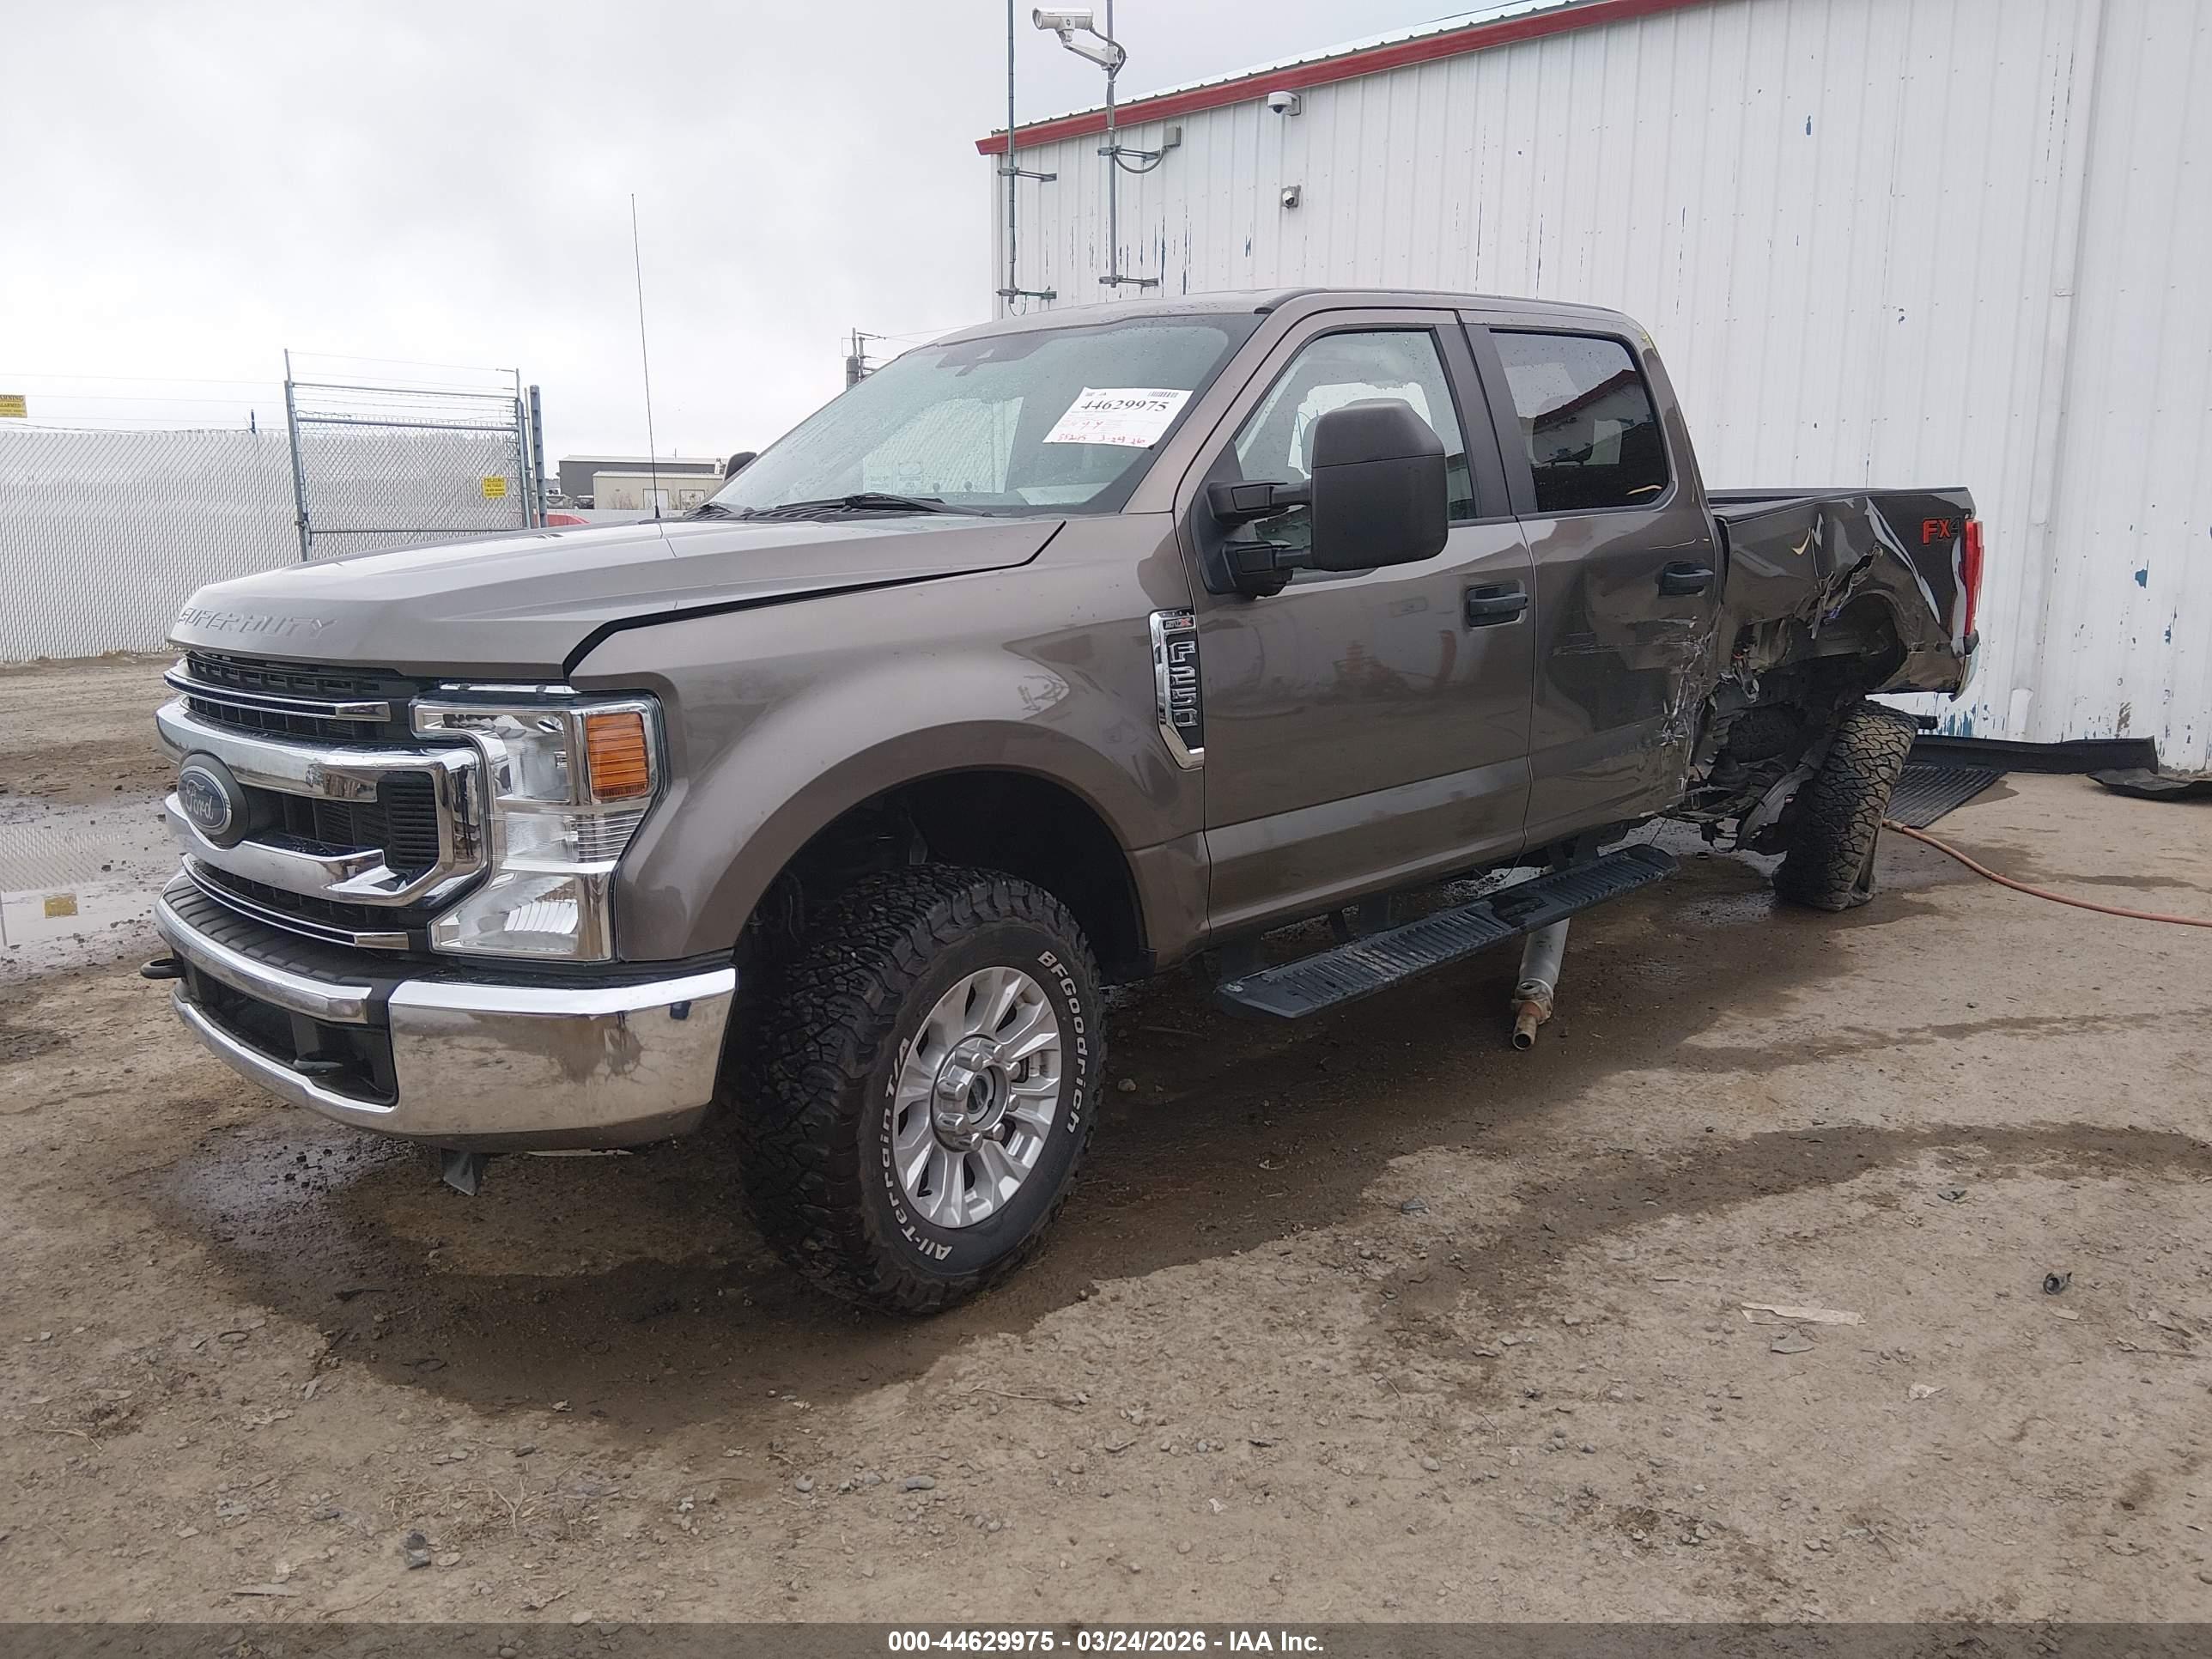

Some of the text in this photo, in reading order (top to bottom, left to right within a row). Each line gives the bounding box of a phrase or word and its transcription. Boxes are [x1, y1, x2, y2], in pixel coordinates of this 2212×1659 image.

[1080, 399, 1170, 412] 44629975
[1923, 517, 1961, 545] FX4
[177, 607, 337, 639] SUPER DUTY
[1168, 641, 1198, 727] F250
[185, 779, 215, 821] Ford
[1037, 950, 1089, 1133] BFGoodrich
[880, 1037, 952, 1261] All-Terrain T/A
